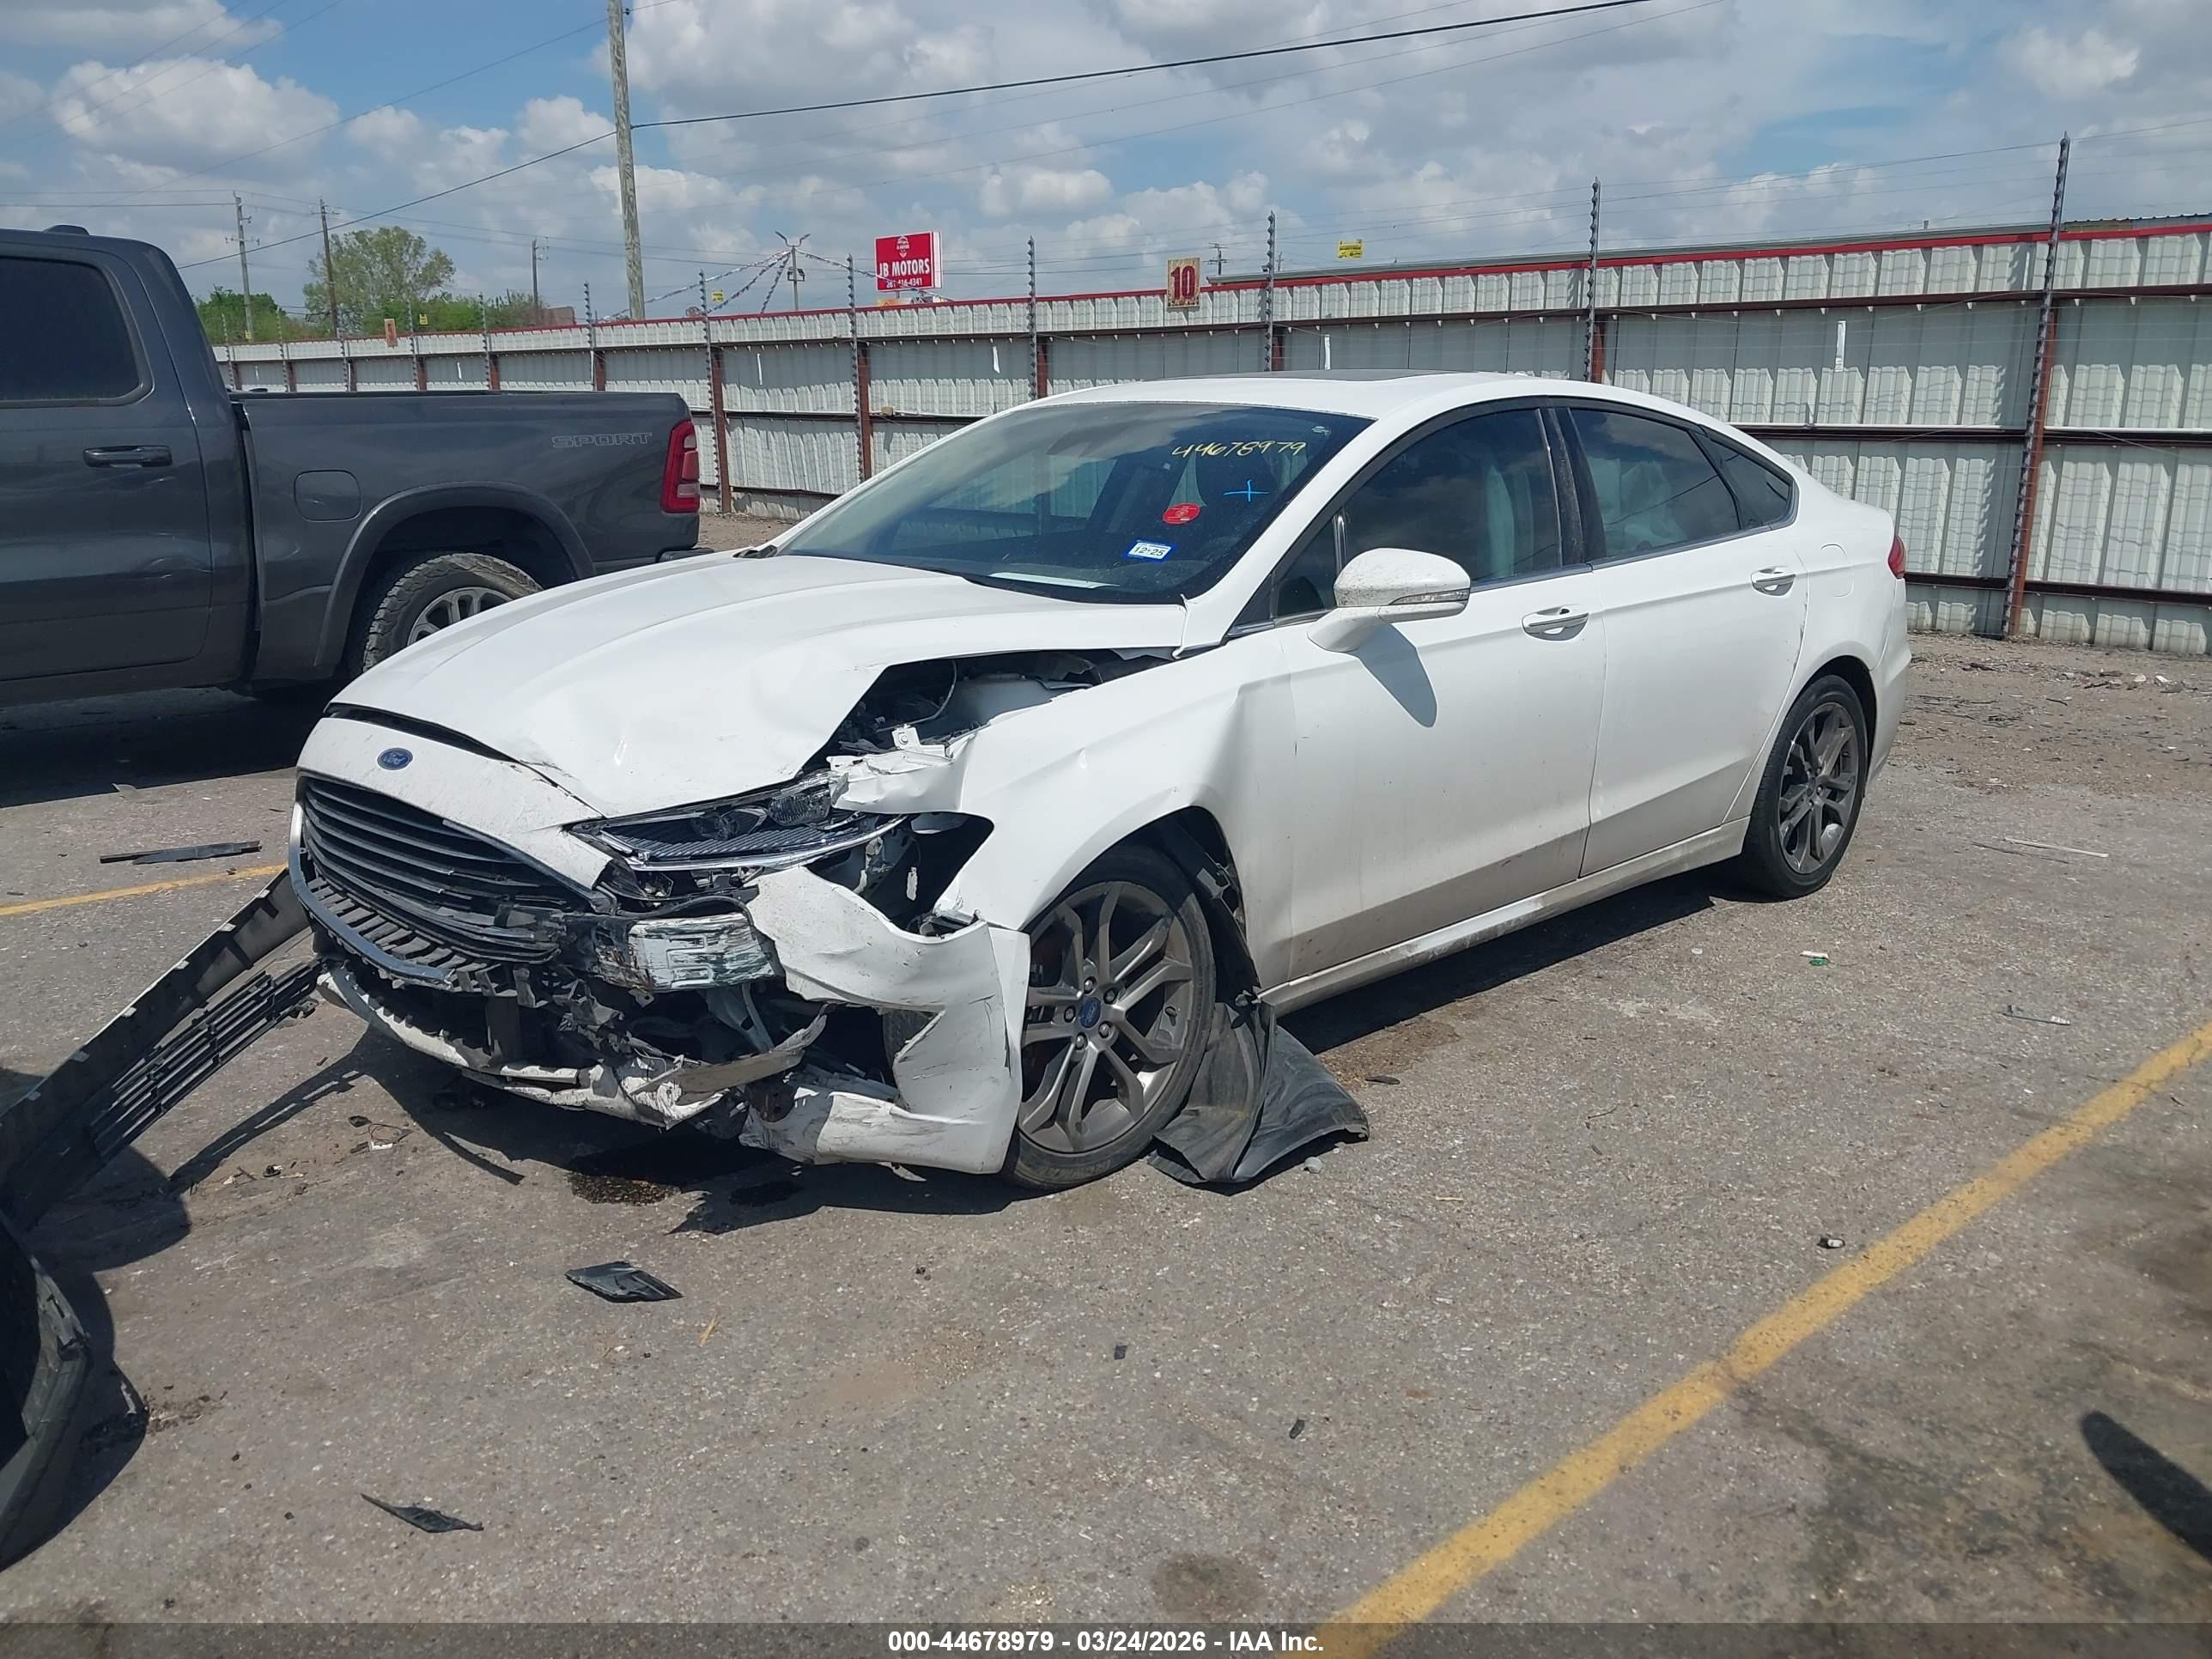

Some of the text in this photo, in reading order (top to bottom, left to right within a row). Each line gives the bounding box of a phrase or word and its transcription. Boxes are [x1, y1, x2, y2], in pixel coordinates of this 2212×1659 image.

[879, 258, 930, 276] JB MOTORS
[1170, 265, 1196, 301] 10
[550, 432, 653, 449] SPORT
[1171, 440, 1307, 459] 44678979
